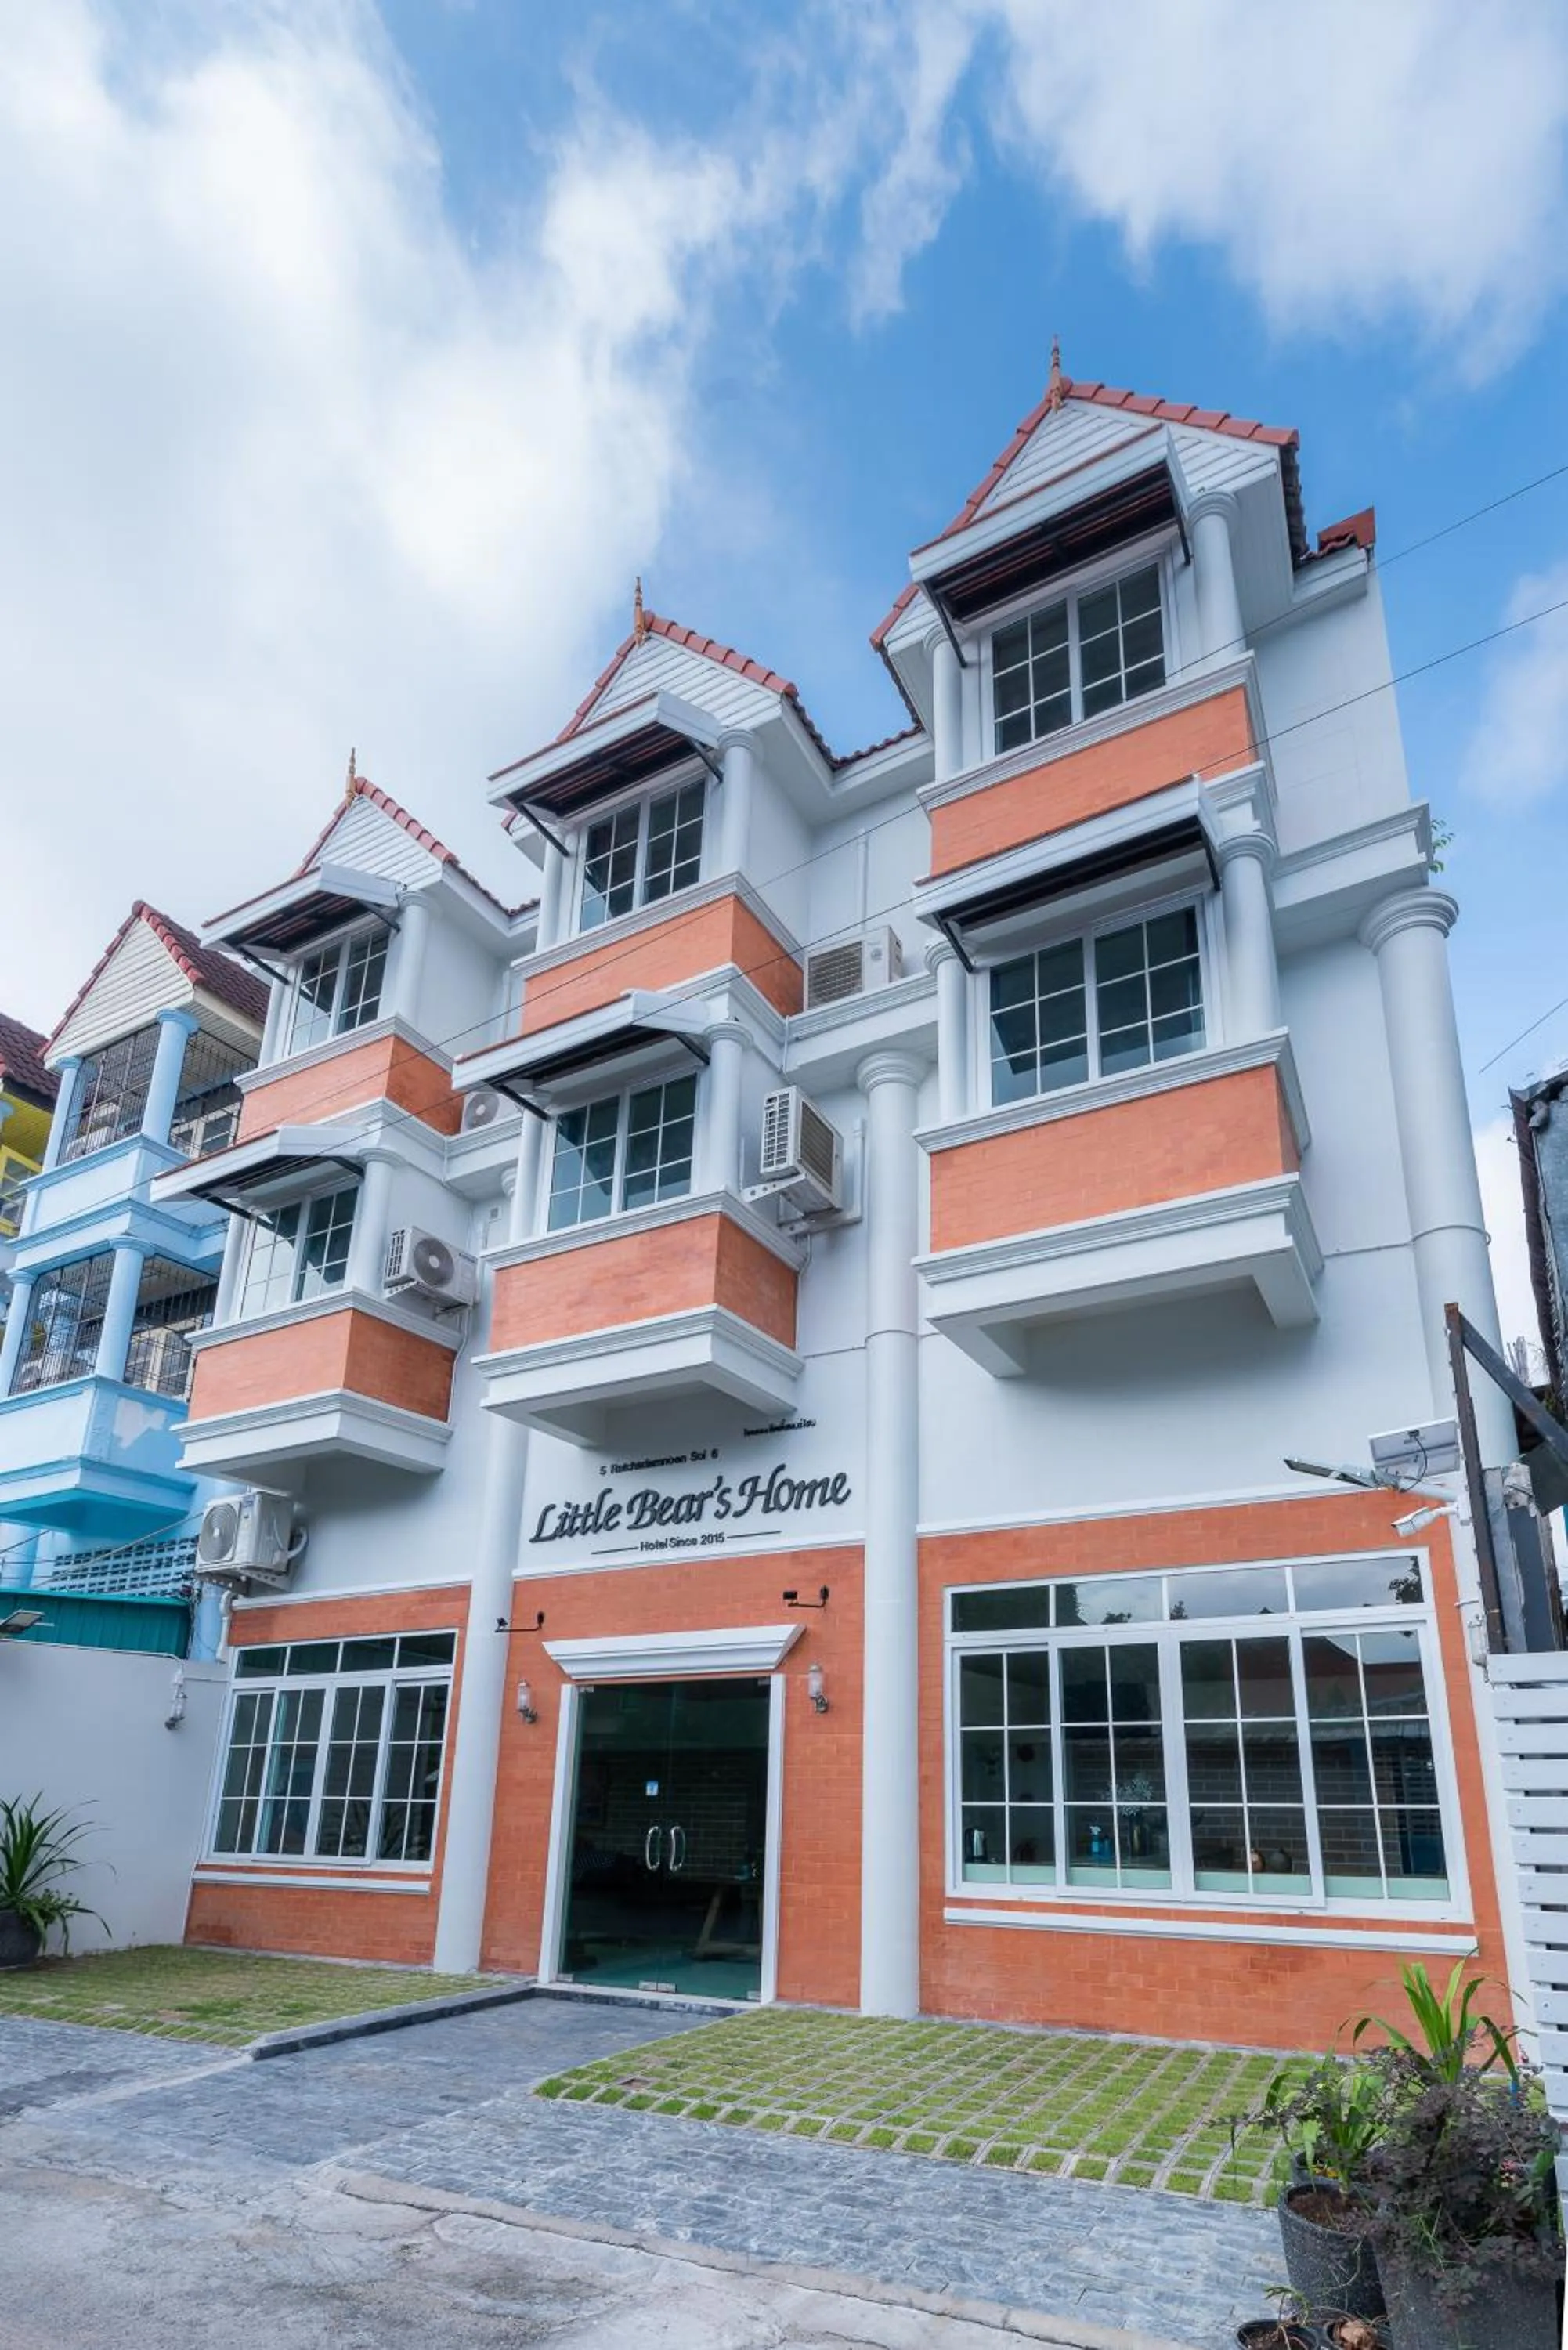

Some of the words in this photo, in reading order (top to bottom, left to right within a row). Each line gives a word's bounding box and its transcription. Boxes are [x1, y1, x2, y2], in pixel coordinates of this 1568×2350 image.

[598, 1466, 608, 1476] 5
[689, 1449, 707, 1462] Soi
[710, 1448, 719, 1459] 6
[529, 1488, 623, 1543] Little
[626, 1475, 732, 1531] Bear's
[731, 1462, 852, 1519] Home
[639, 1538, 669, 1552] Hotel
[669, 1536, 699, 1549] Since
[699, 1531, 726, 1546] 2015
